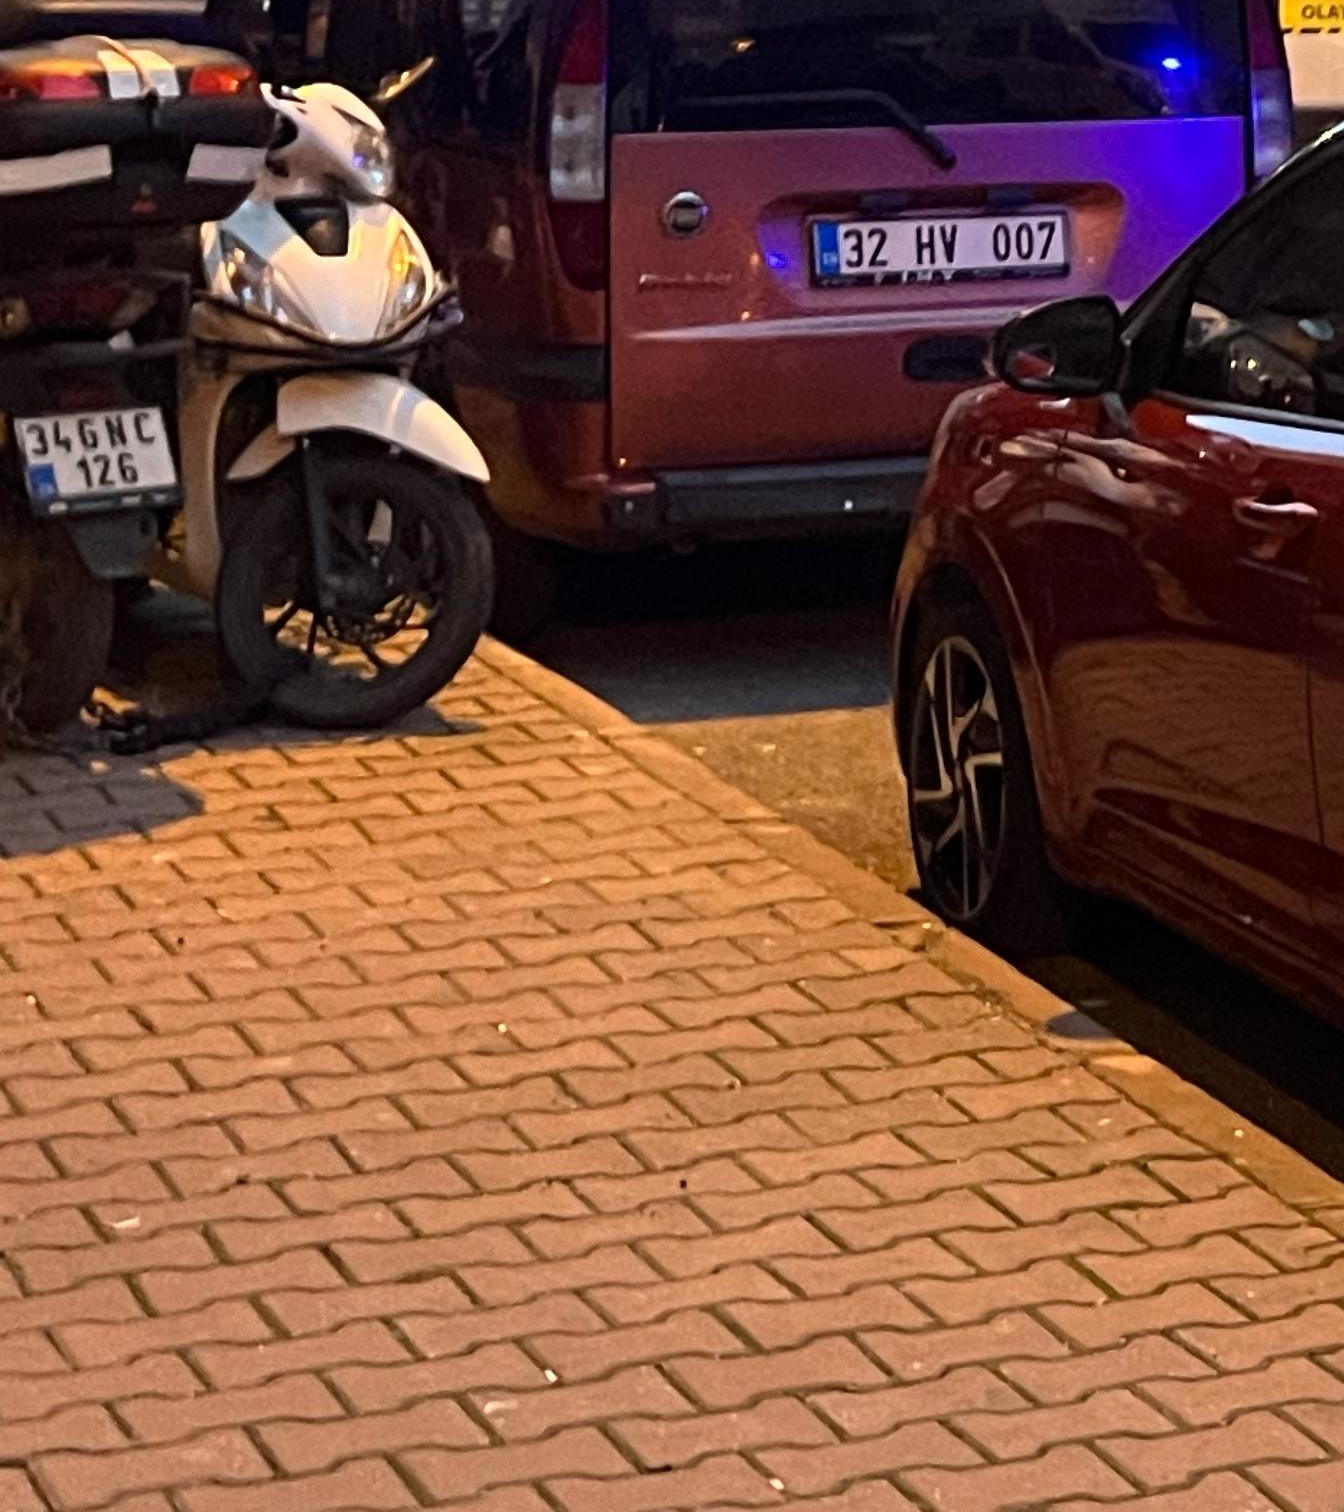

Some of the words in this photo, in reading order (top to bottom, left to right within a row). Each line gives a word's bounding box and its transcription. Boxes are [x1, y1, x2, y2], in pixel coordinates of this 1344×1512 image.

[843, 227, 889, 268] 32
[915, 224, 958, 265] HV
[992, 221, 1057, 262] 007
[76, 453, 139, 488] 126
